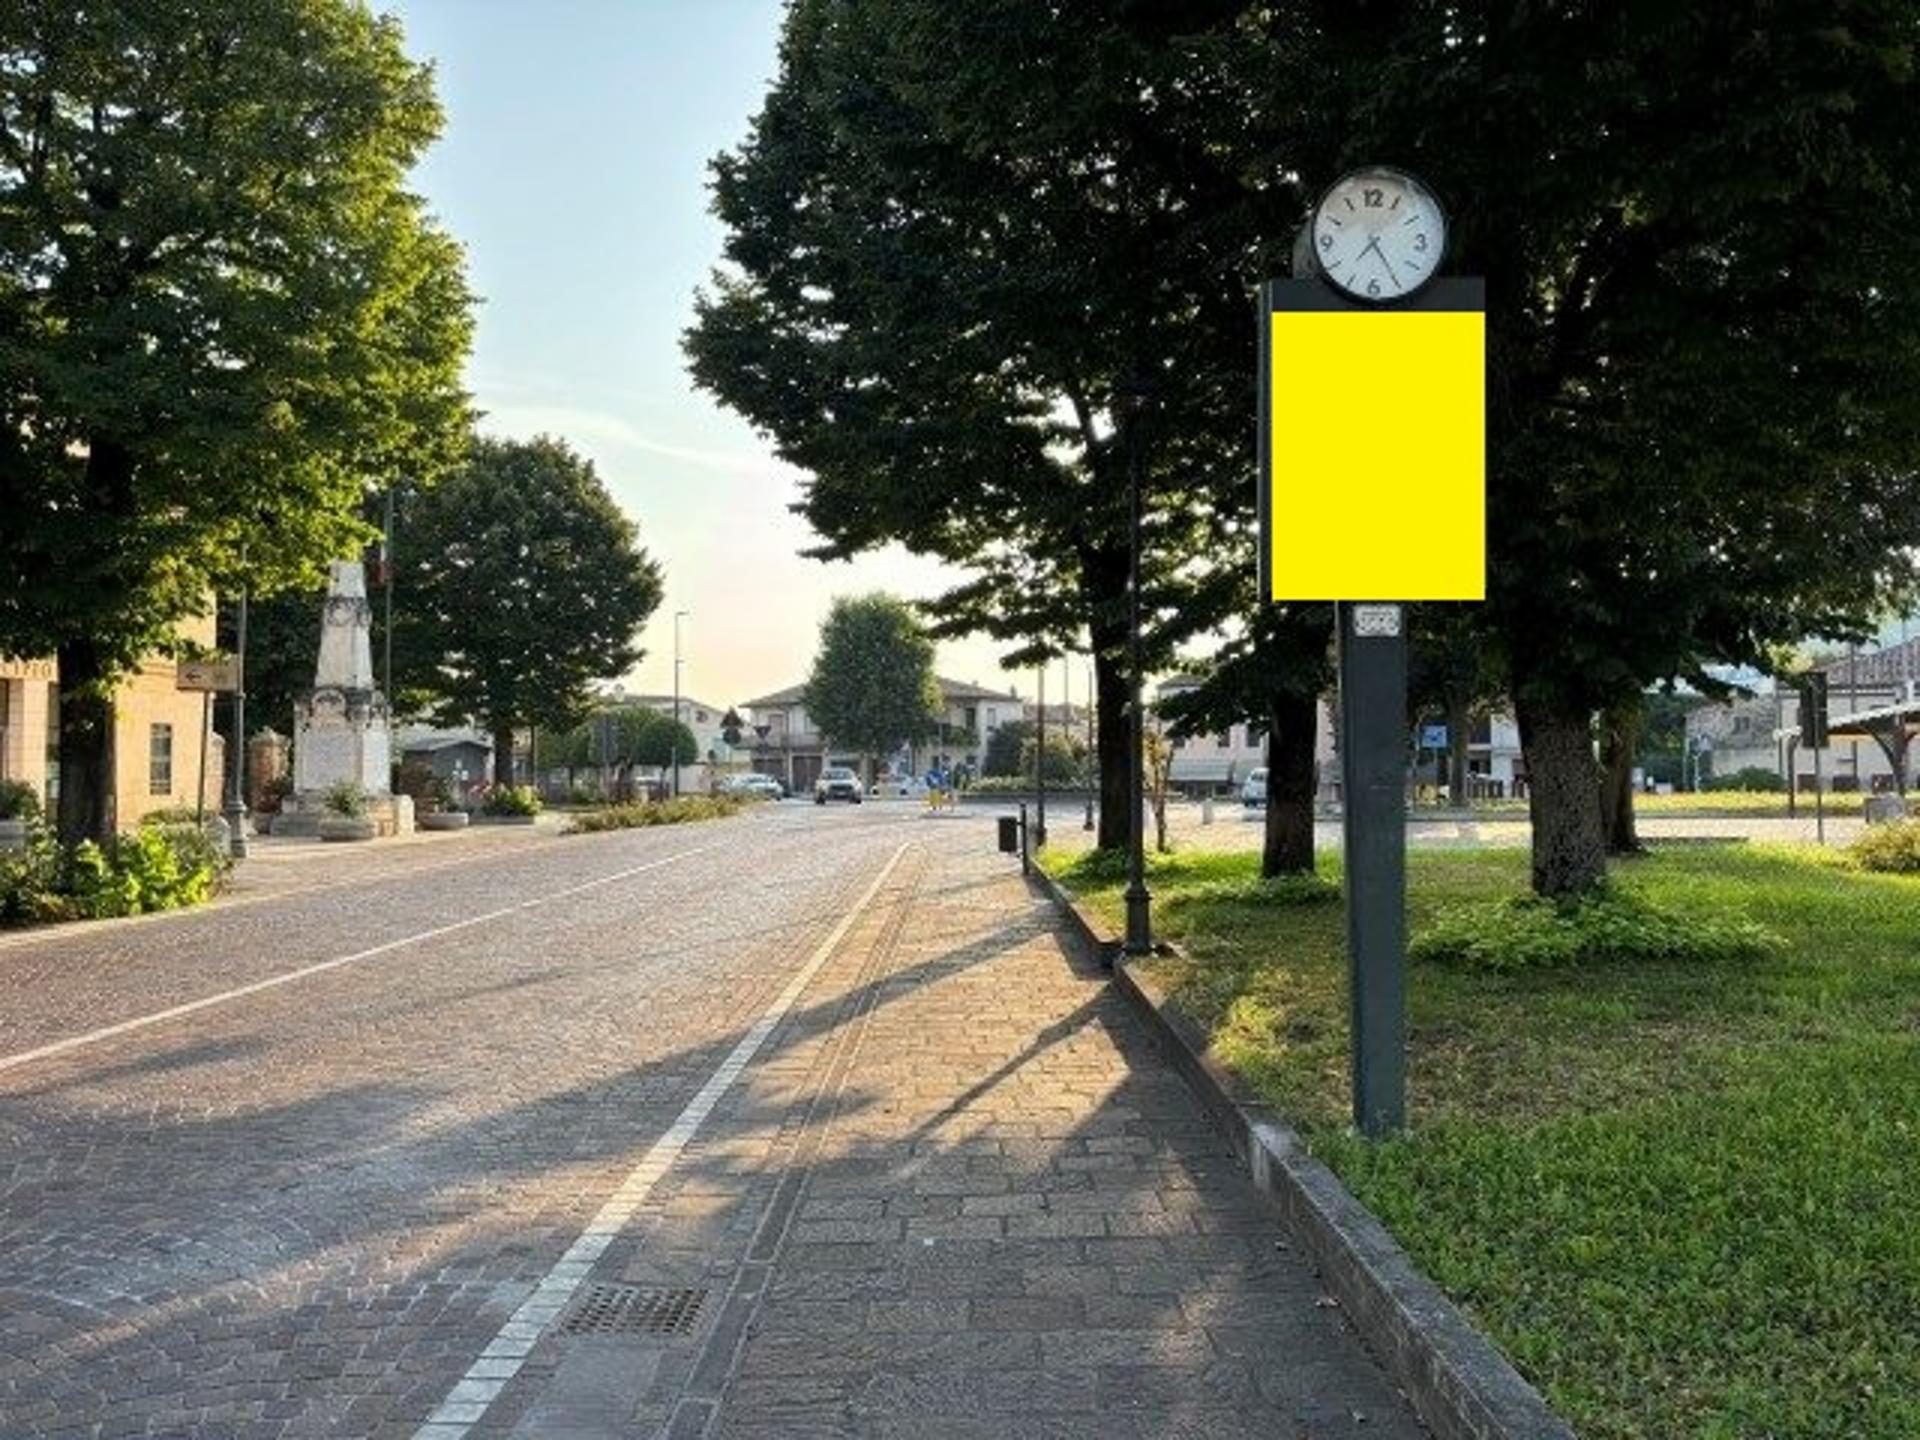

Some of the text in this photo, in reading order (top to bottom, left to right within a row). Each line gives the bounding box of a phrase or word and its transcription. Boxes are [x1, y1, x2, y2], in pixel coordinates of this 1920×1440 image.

[1363, 189, 1384, 207] 12
[1320, 235, 1334, 252] 9
[1414, 234, 1426, 251] 3
[1367, 279, 1380, 296] 6
